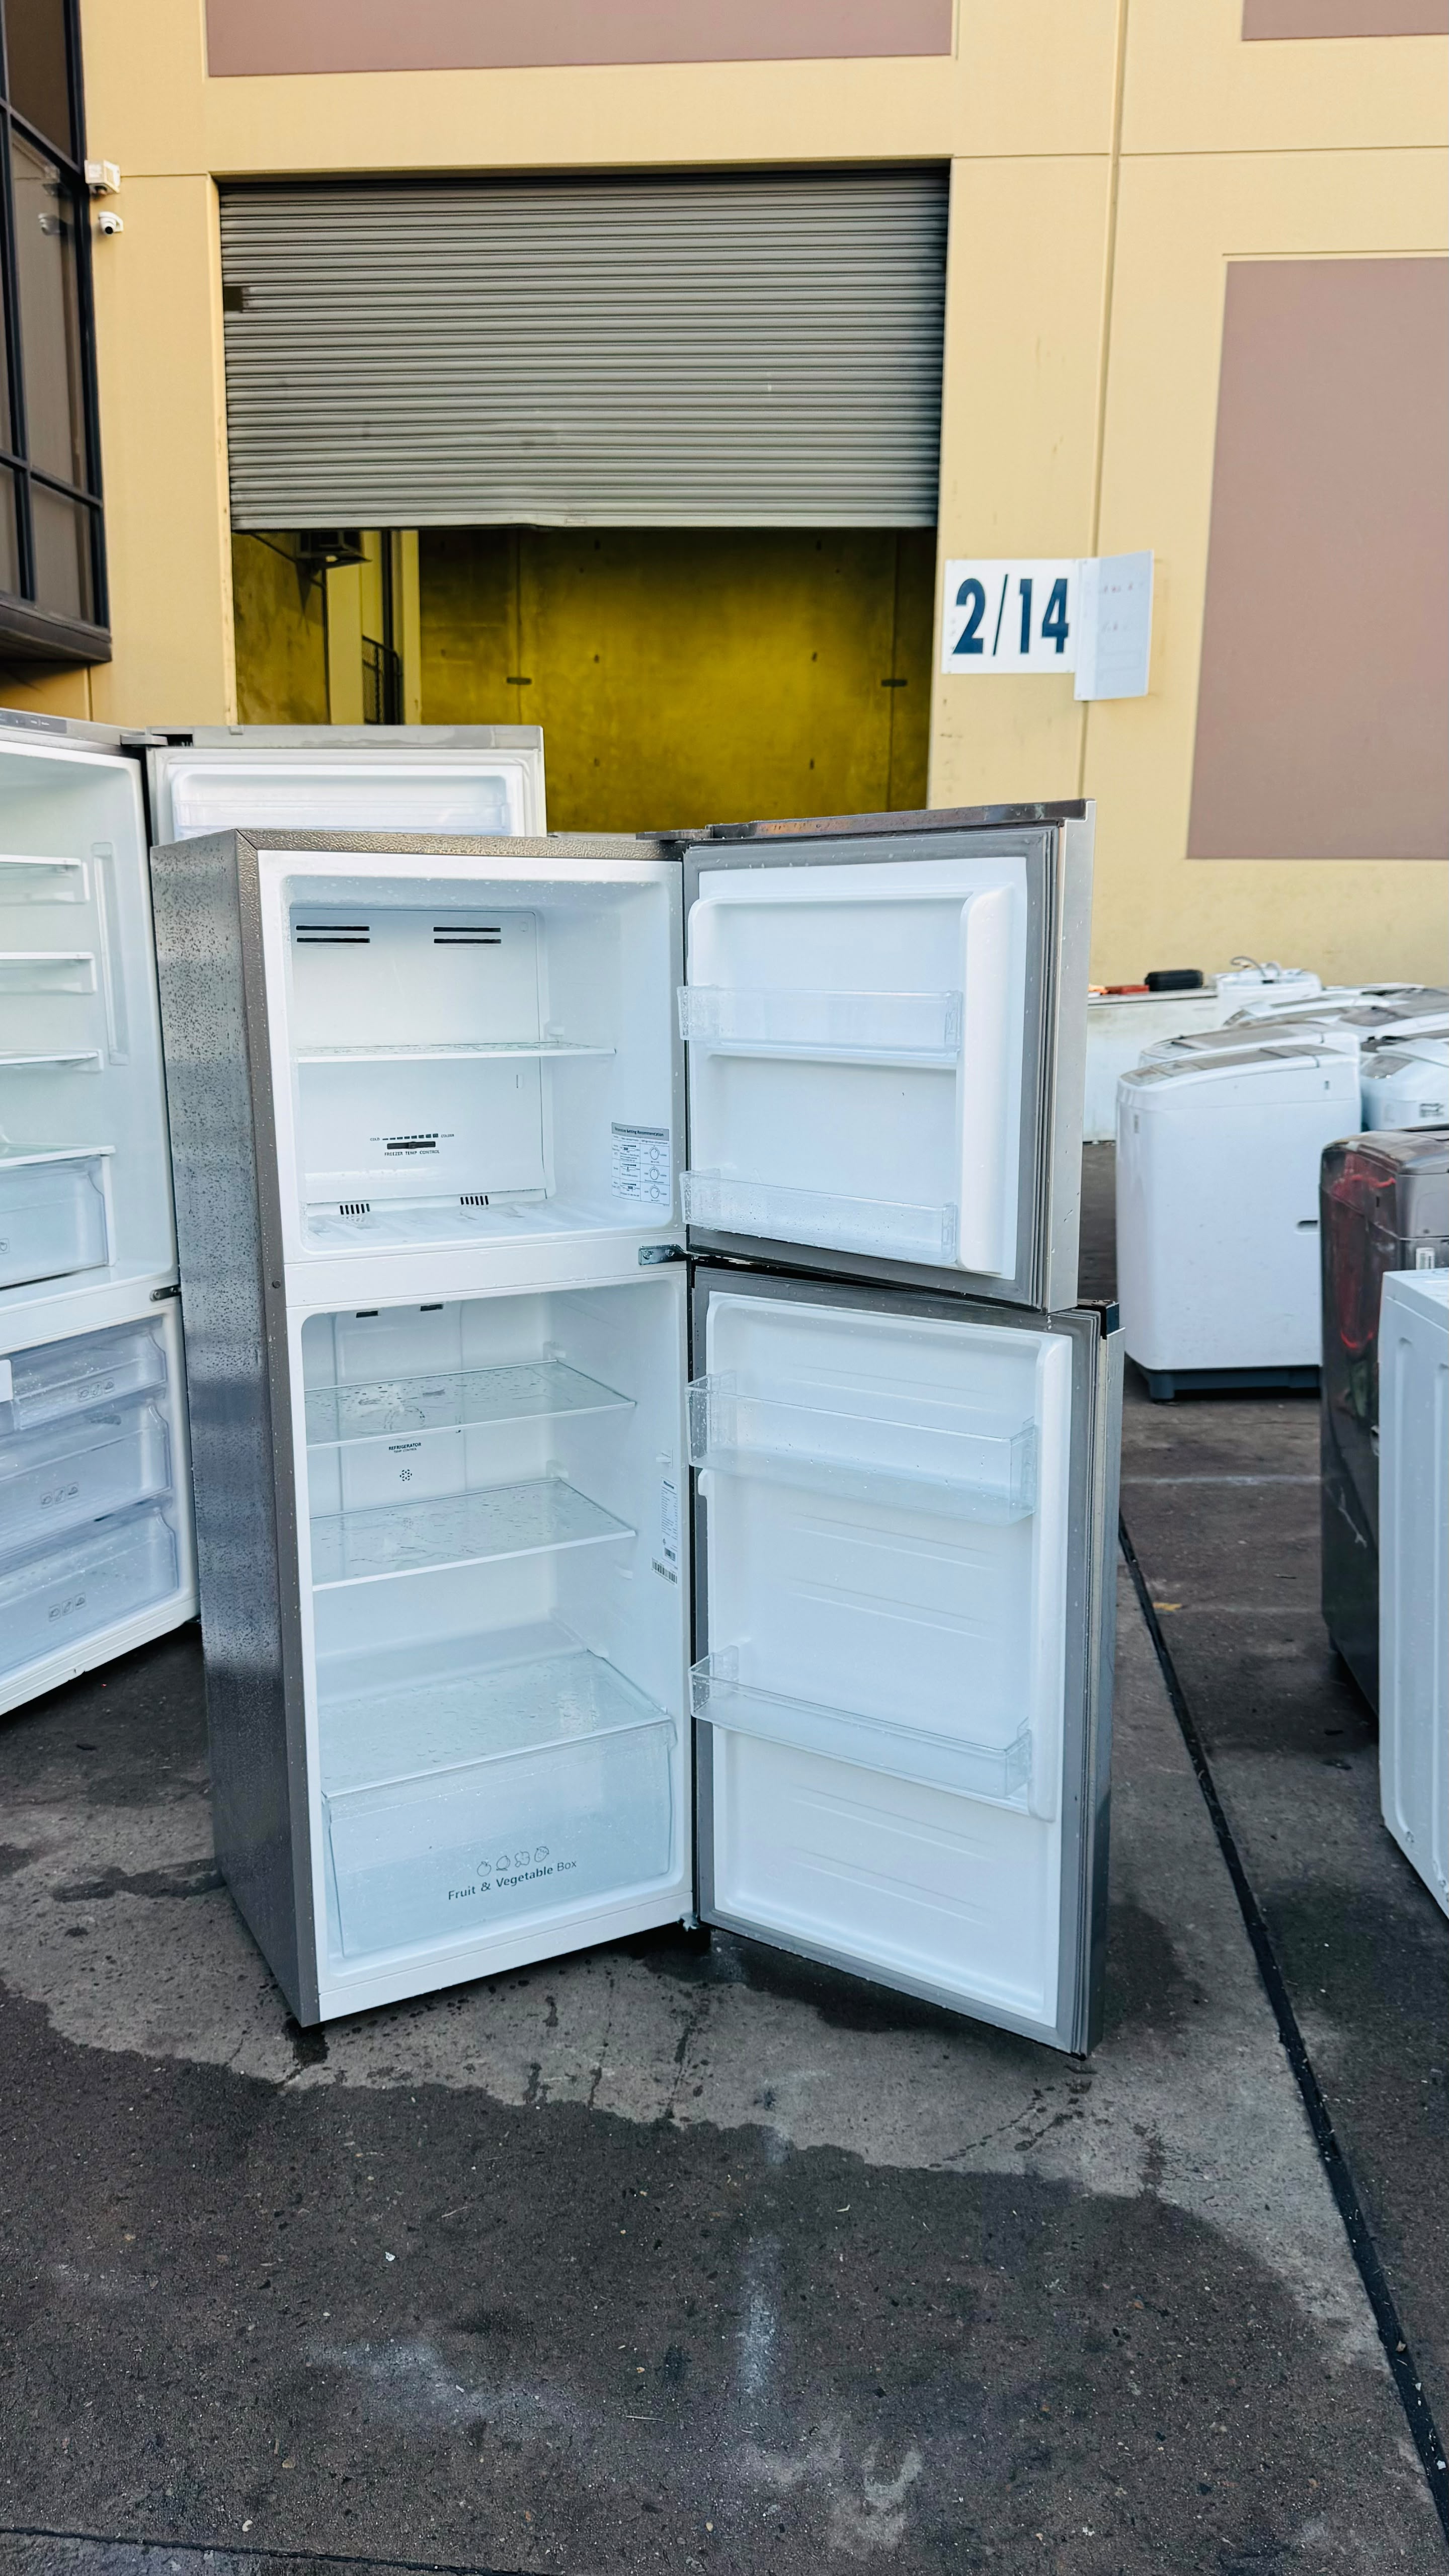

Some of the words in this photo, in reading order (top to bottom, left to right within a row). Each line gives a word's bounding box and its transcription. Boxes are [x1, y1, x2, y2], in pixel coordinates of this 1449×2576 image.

[952, 574, 1070, 657] 2/14
[448, 1886, 476, 1900] Fruit
[480, 1882, 491, 1892] &
[496, 1866, 553, 1887] Vegetable
[556, 1860, 577, 1872] Box
